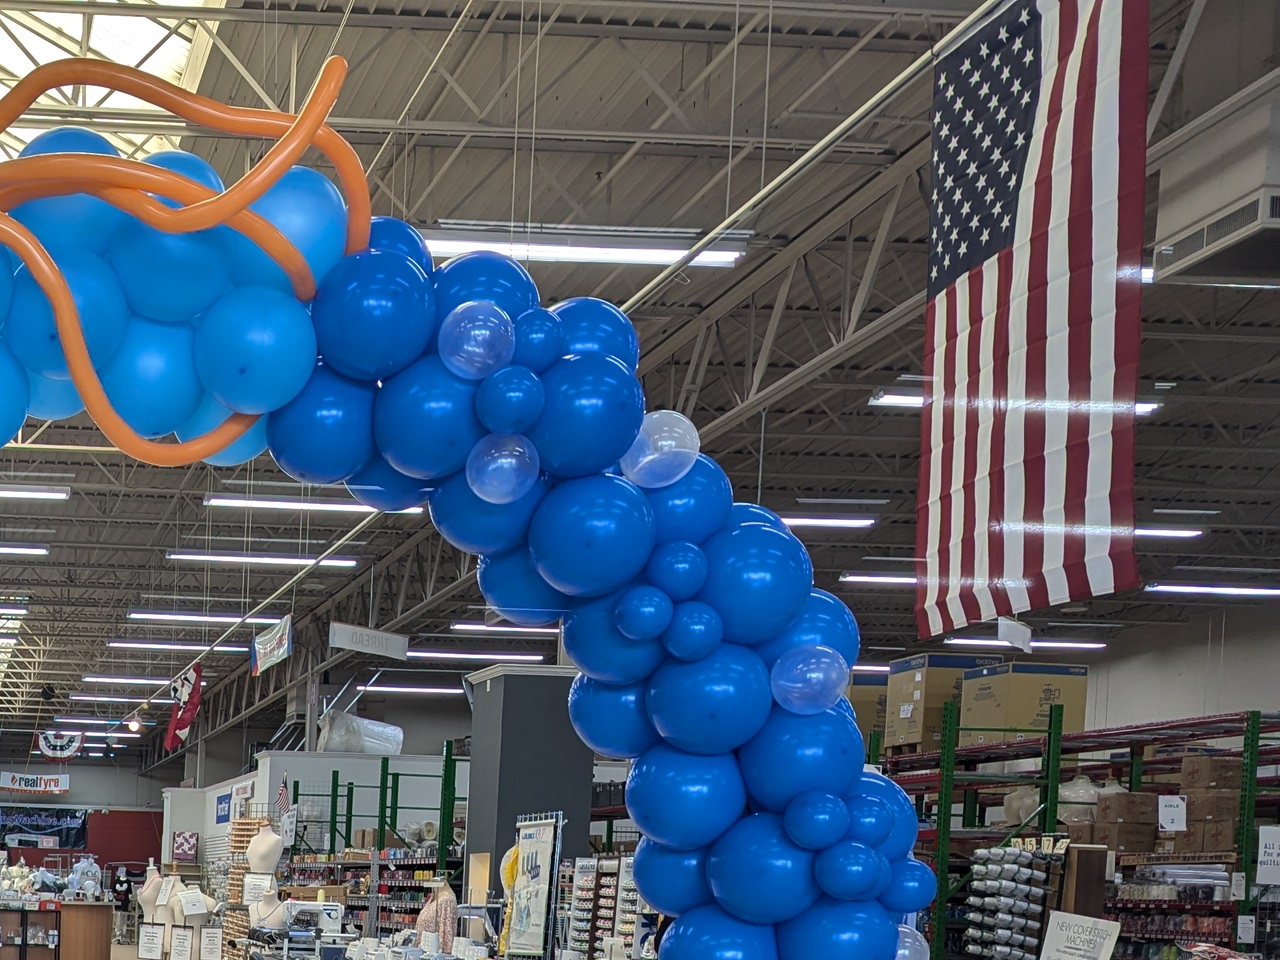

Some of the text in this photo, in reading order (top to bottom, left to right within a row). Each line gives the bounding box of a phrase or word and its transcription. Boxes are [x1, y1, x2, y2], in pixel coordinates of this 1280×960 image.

[18, 776, 60, 790] realfyre
[1025, 839, 1034, 852] 15
[1042, 838, 1051, 852] 17
[1259, 858, 1280, 867] quilti
[1056, 920, 1073, 933] NEW
[1064, 934, 1098, 950] MACHINES
